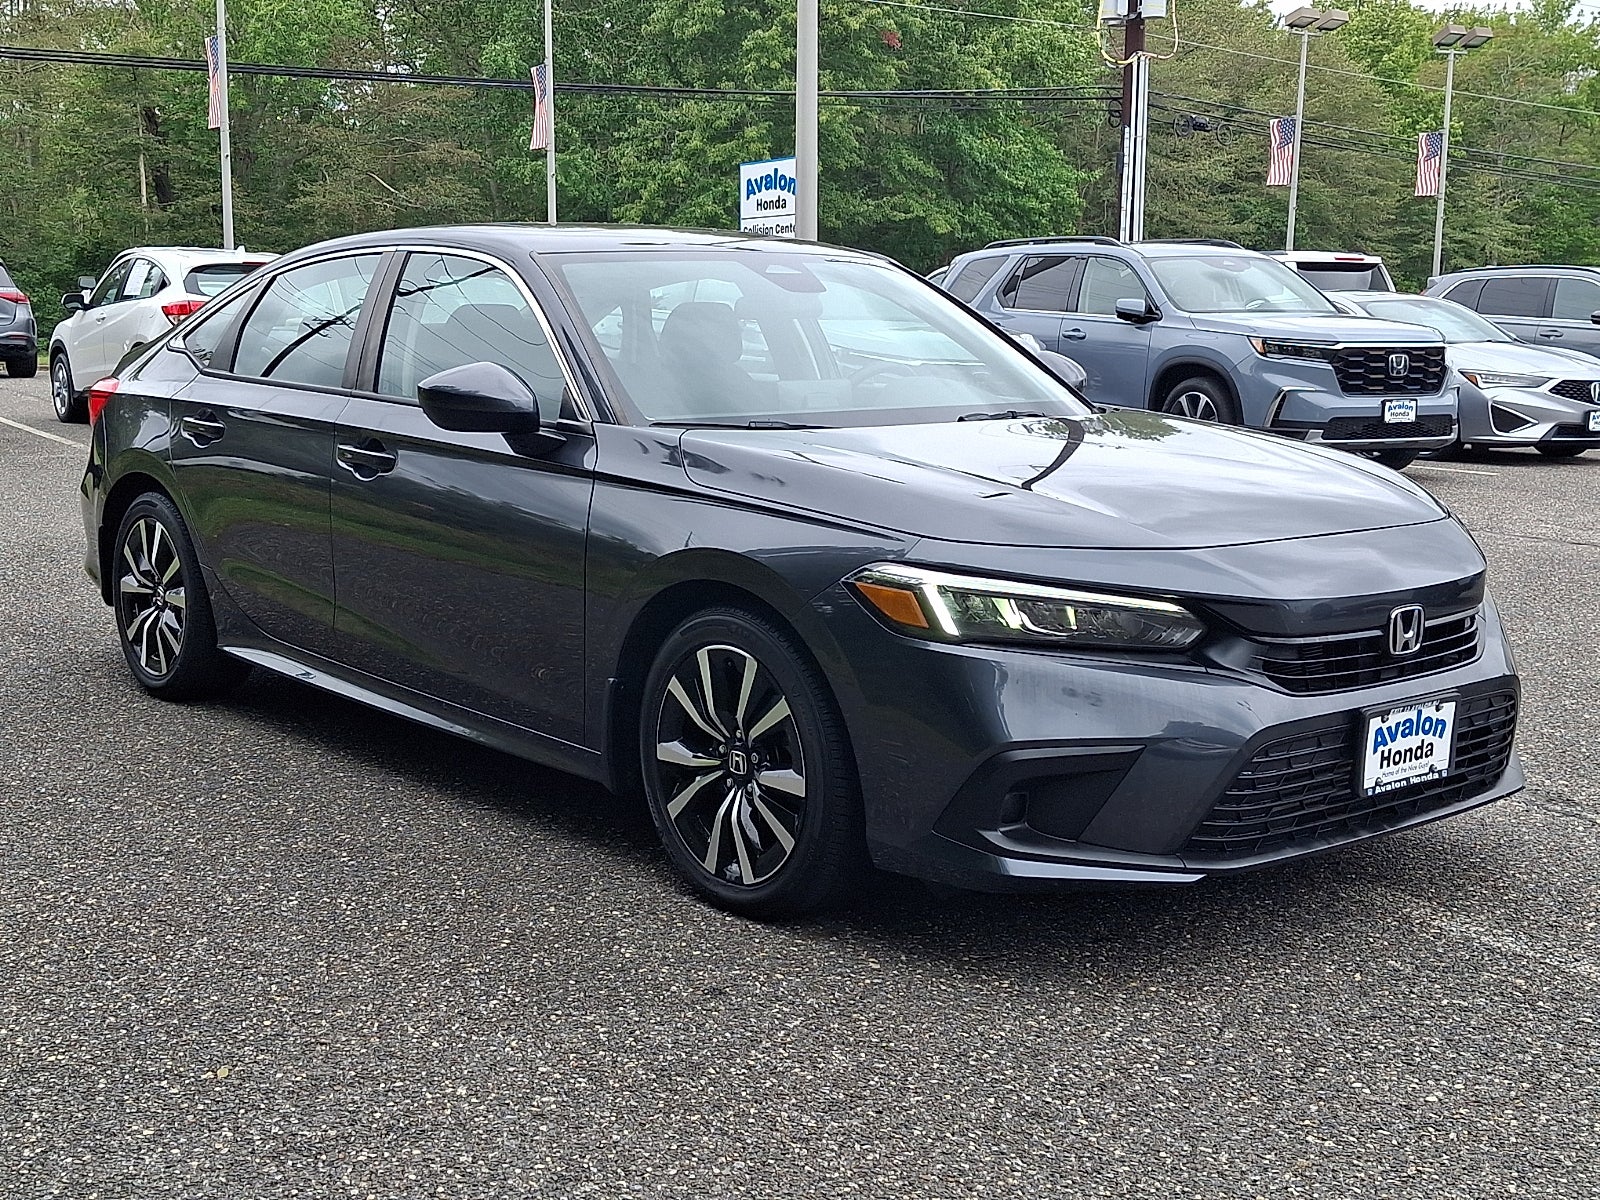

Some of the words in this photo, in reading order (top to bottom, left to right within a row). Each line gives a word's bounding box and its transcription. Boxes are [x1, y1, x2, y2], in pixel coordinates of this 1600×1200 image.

[746, 167, 796, 201] Avalon
[756, 195, 787, 211] Honda
[775, 222, 796, 234] Cente
[1388, 402, 1413, 412] Avalon
[1373, 709, 1446, 755] Avalon
[1379, 738, 1434, 769] Honda
[1375, 780, 1407, 794] Avalon
[1410, 772, 1439, 784] Honda
